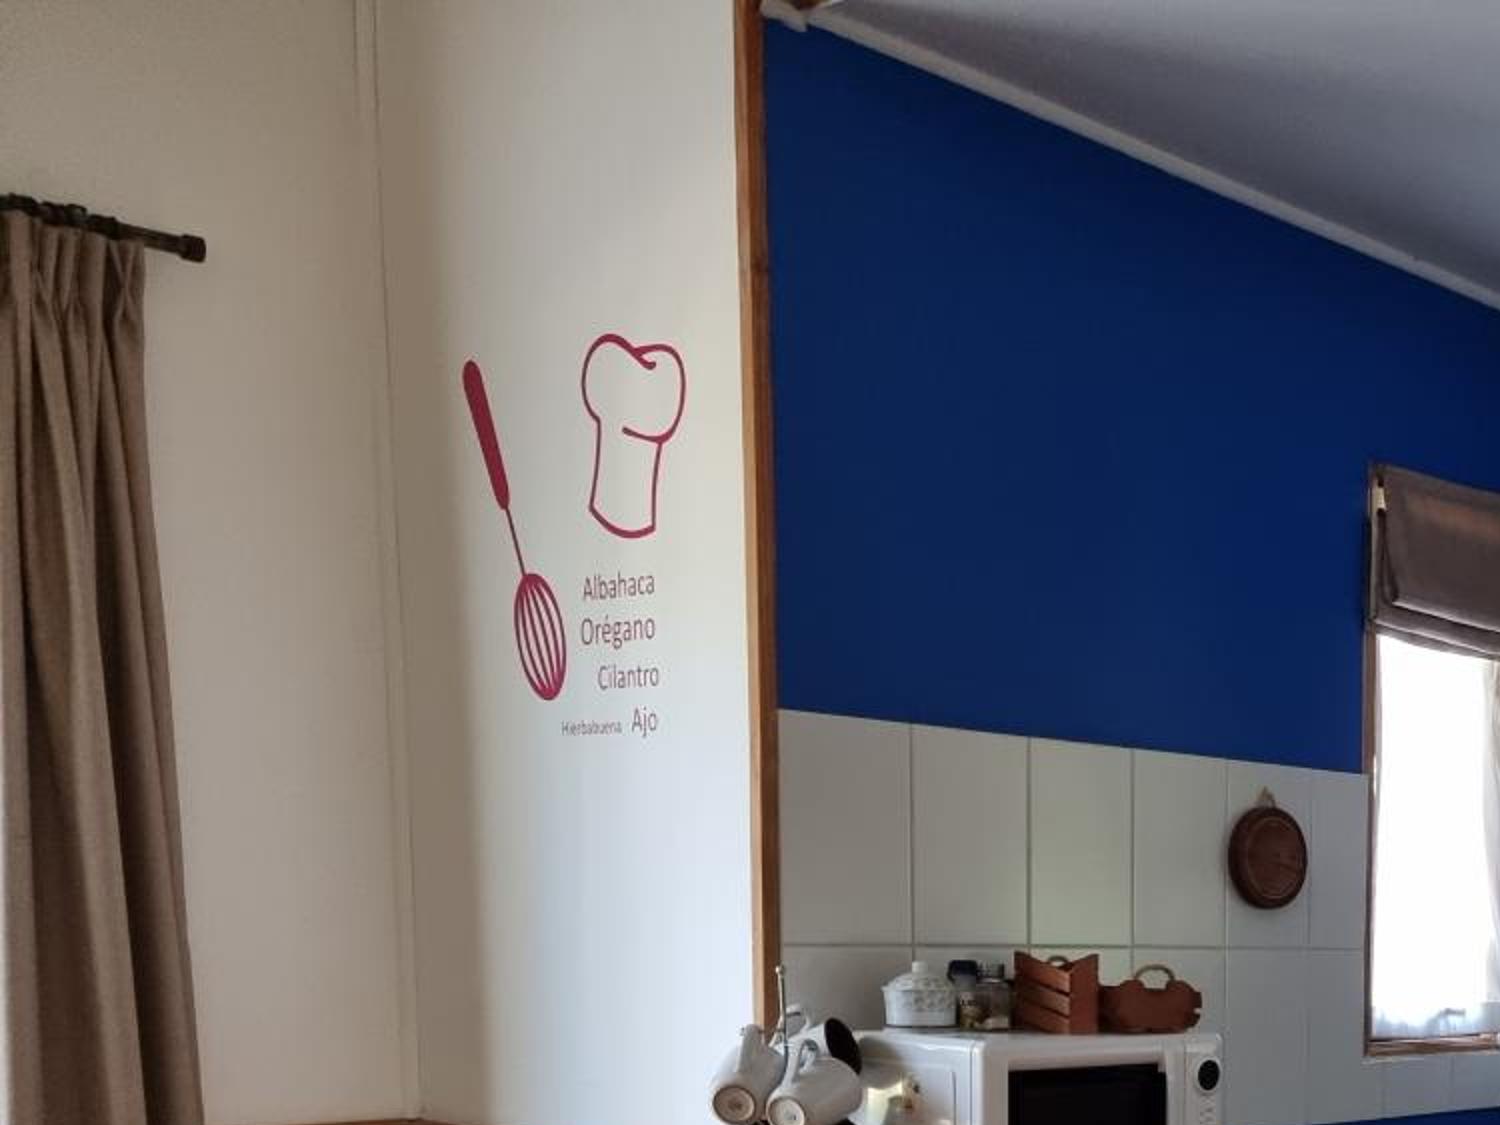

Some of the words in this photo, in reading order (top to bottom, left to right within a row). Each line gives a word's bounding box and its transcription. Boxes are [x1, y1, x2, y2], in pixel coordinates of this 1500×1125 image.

[583, 571, 656, 600] Albahaca
[581, 615, 656, 649] Orégano
[598, 663, 660, 690] Cilantro
[631, 706, 658, 738] Ajo
